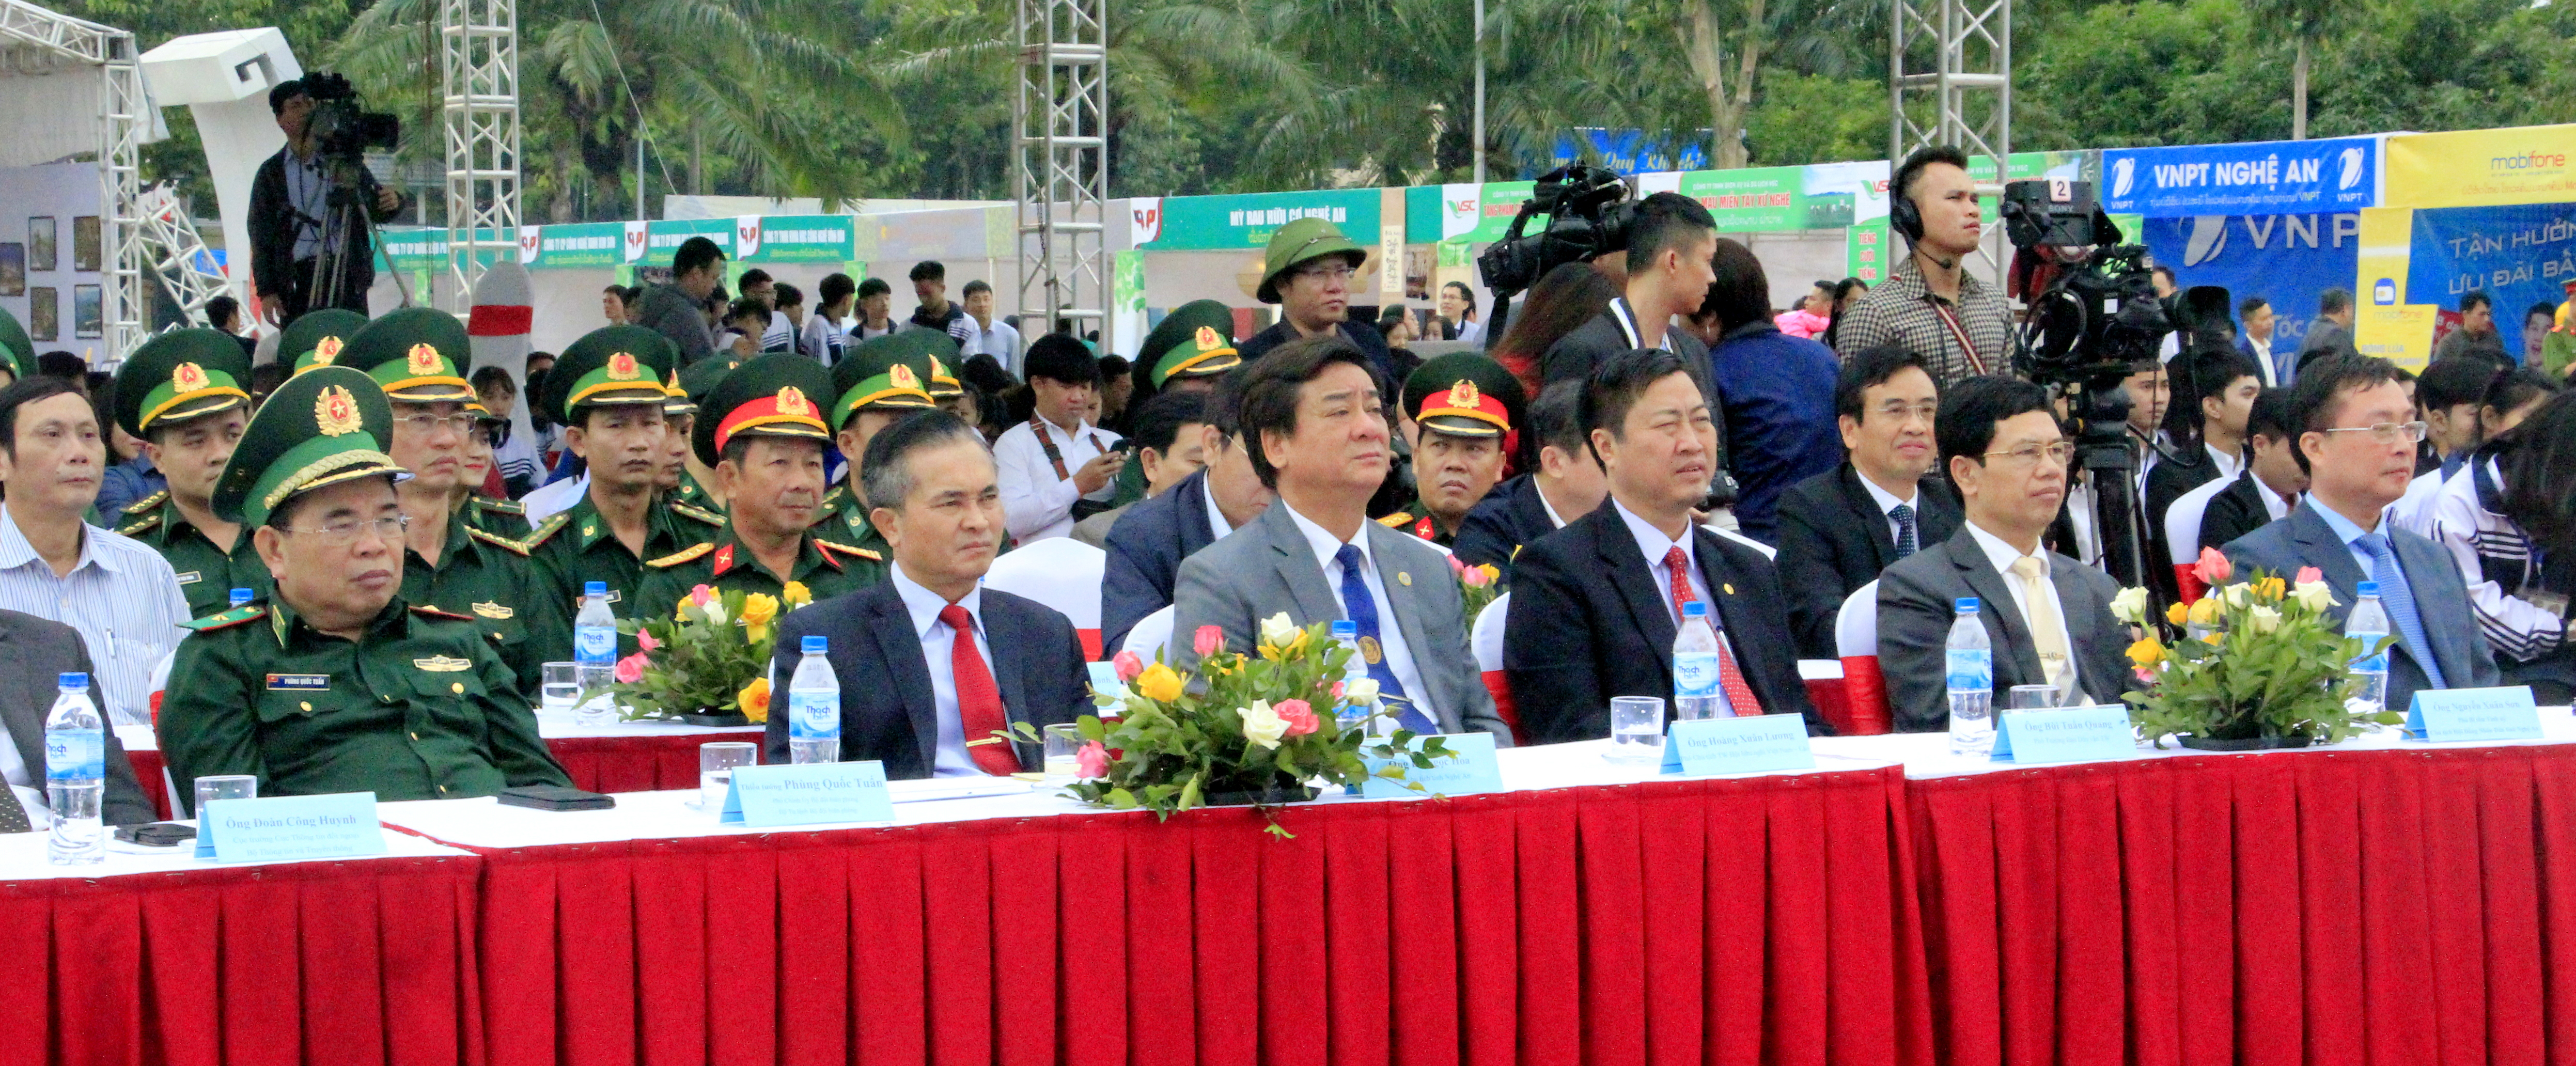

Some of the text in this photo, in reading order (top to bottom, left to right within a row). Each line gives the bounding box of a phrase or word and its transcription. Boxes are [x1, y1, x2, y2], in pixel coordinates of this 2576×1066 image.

[2491, 150, 2565, 169] mobifone
[2155, 153, 2319, 191] VNPT NGHỆ AN
[1873, 180, 1891, 192] VS
[2056, 180, 2066, 196] 2
[1720, 191, 1739, 208] MIỀN
[1742, 192, 1755, 207] TÂY
[1757, 191, 1768, 207] XỨ
[1769, 191, 1790, 209] NGHỆ
[2111, 200, 2134, 209] VNPT
[2299, 192, 2321, 201] VNPT
[2338, 193, 2362, 202] VNPT
[1457, 200, 1476, 211] VSC
[1246, 210, 1264, 225] RAU
[1267, 207, 1286, 225] HỮU
[1332, 207, 1346, 223] AN
[1859, 229, 1877, 245] TIẾNG
[2244, 213, 2360, 249] VNP
[2448, 217, 2576, 260] TẬN HƯỞN
[1859, 265, 1877, 279] TIẾNG
[2449, 248, 2576, 294] ƯU ĐÃI BẤ
[2433, 701, 2451, 712] Ông
[2452, 700, 2481, 712] Nguyễn
[2483, 701, 2504, 709] Xuân
[2025, 720, 2043, 732] Ông
[2085, 721, 2113, 730] Quang
[1688, 732, 1796, 748] Ông Hoàng Xuân Lương
[1433, 757, 1470, 769] gọc Hoa
[784, 779, 820, 792] Phùng
[822, 776, 851, 791] Quốc
[854, 775, 883, 789] Tuấn
[226, 814, 357, 829] Ông Đoàn Công Huynh
